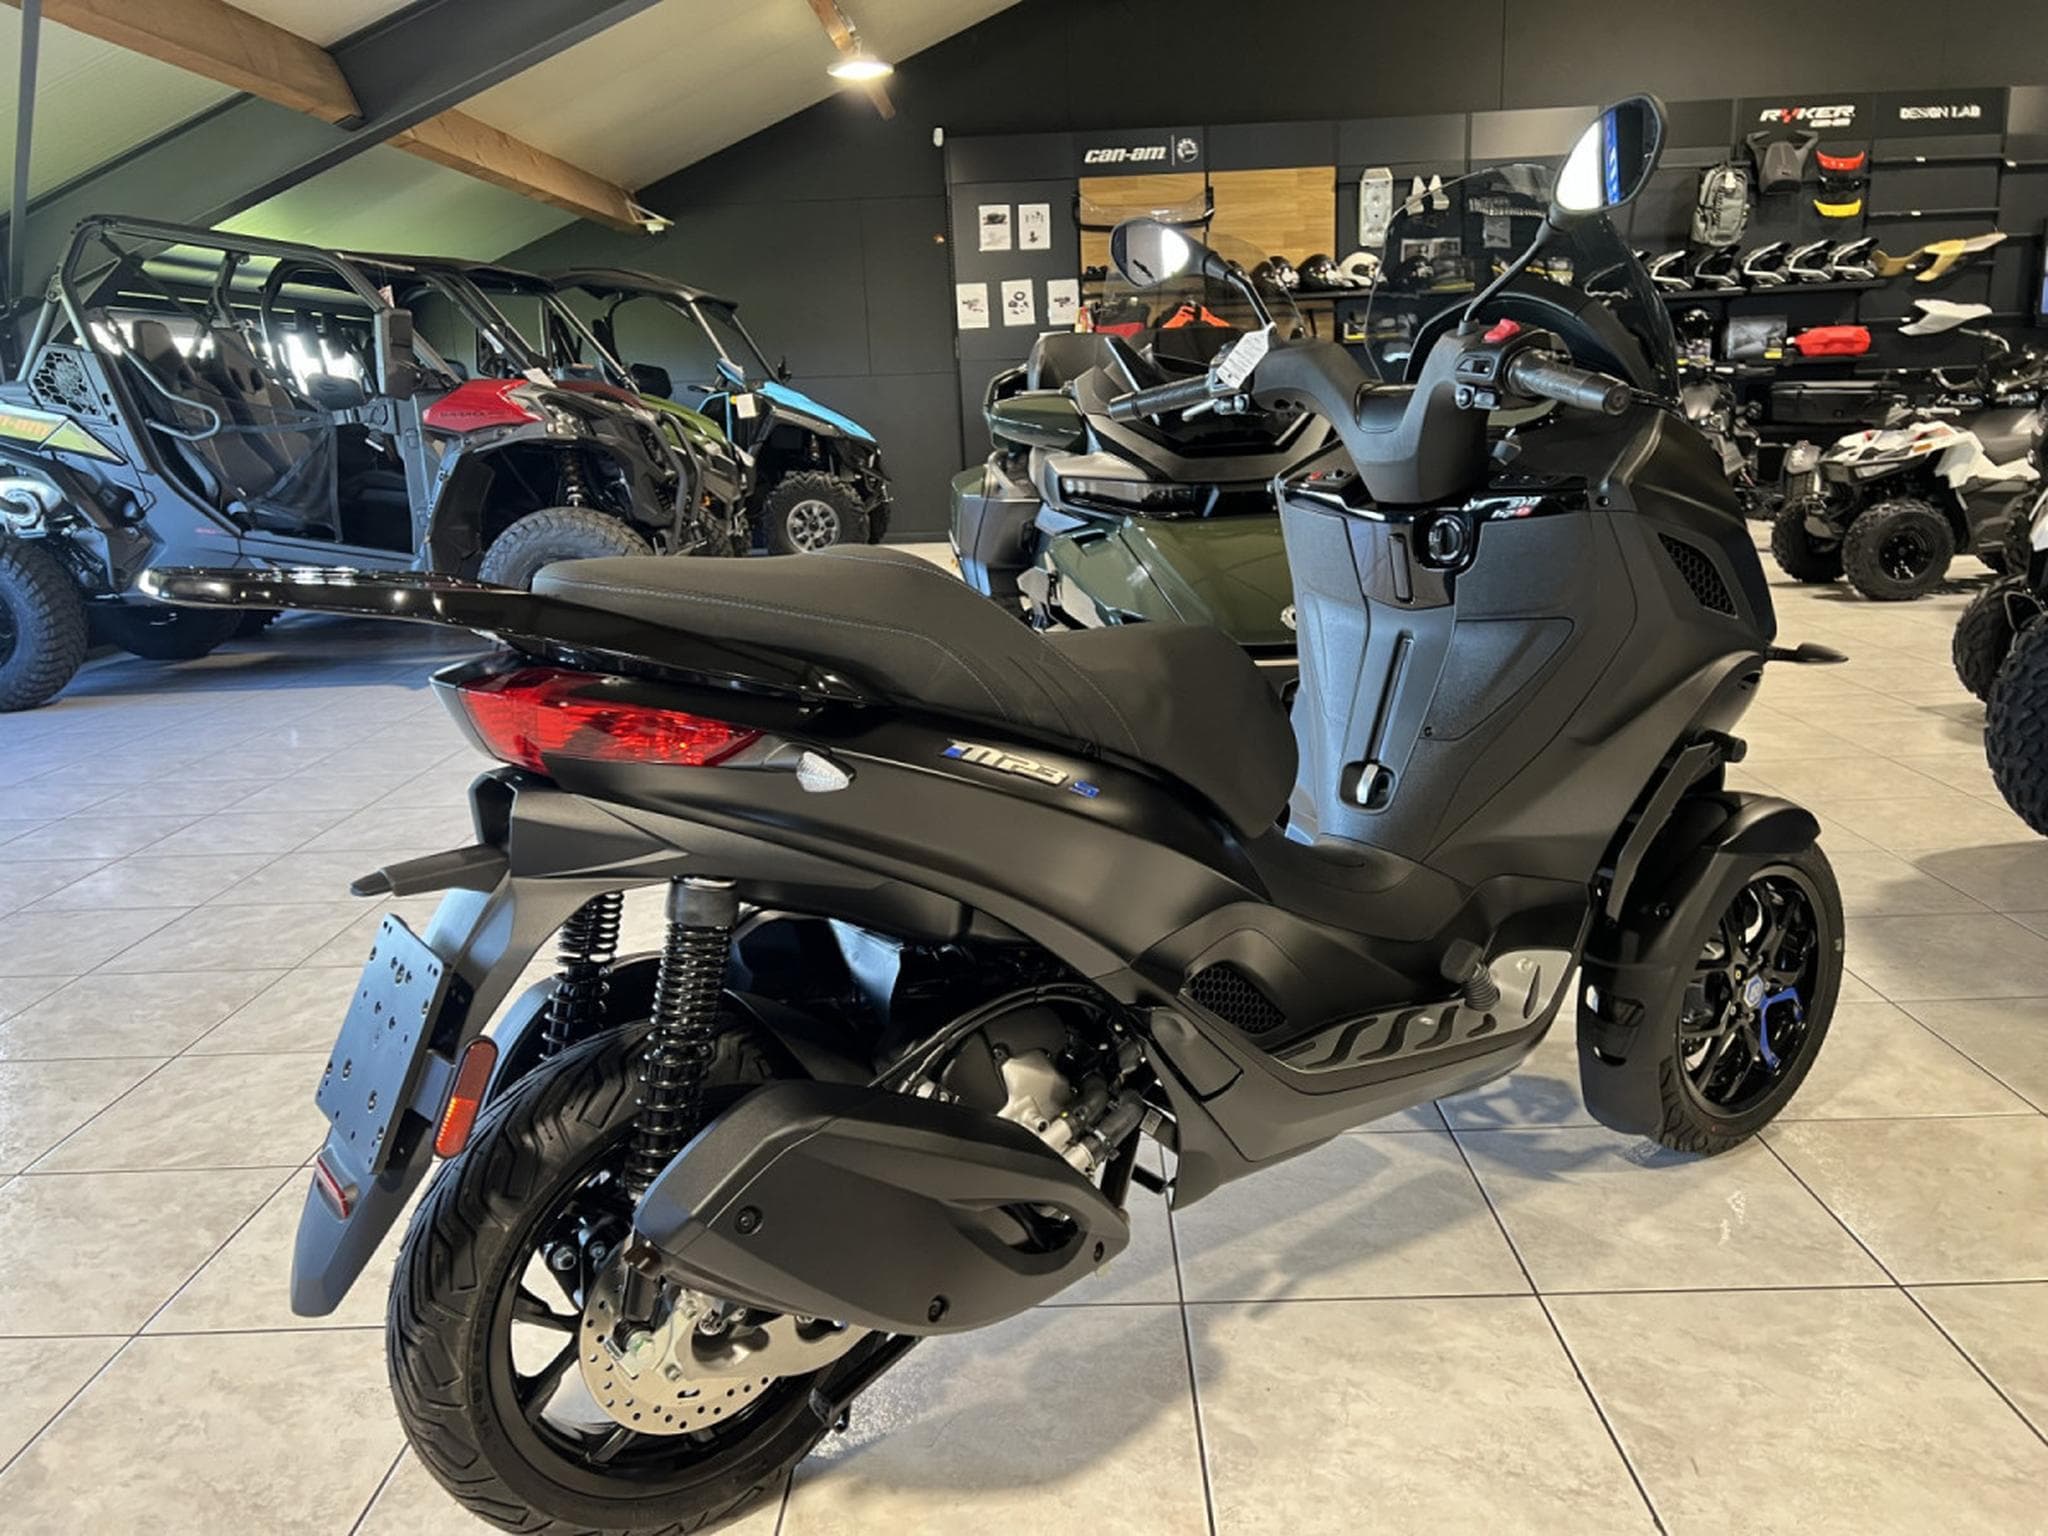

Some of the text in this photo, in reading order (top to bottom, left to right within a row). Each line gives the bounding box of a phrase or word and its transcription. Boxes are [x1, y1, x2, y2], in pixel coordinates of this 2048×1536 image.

[1760, 105, 1855, 124] RYKER
[1900, 105, 1981, 119] DESIGN LAB
[1084, 147, 1166, 163] can-am
